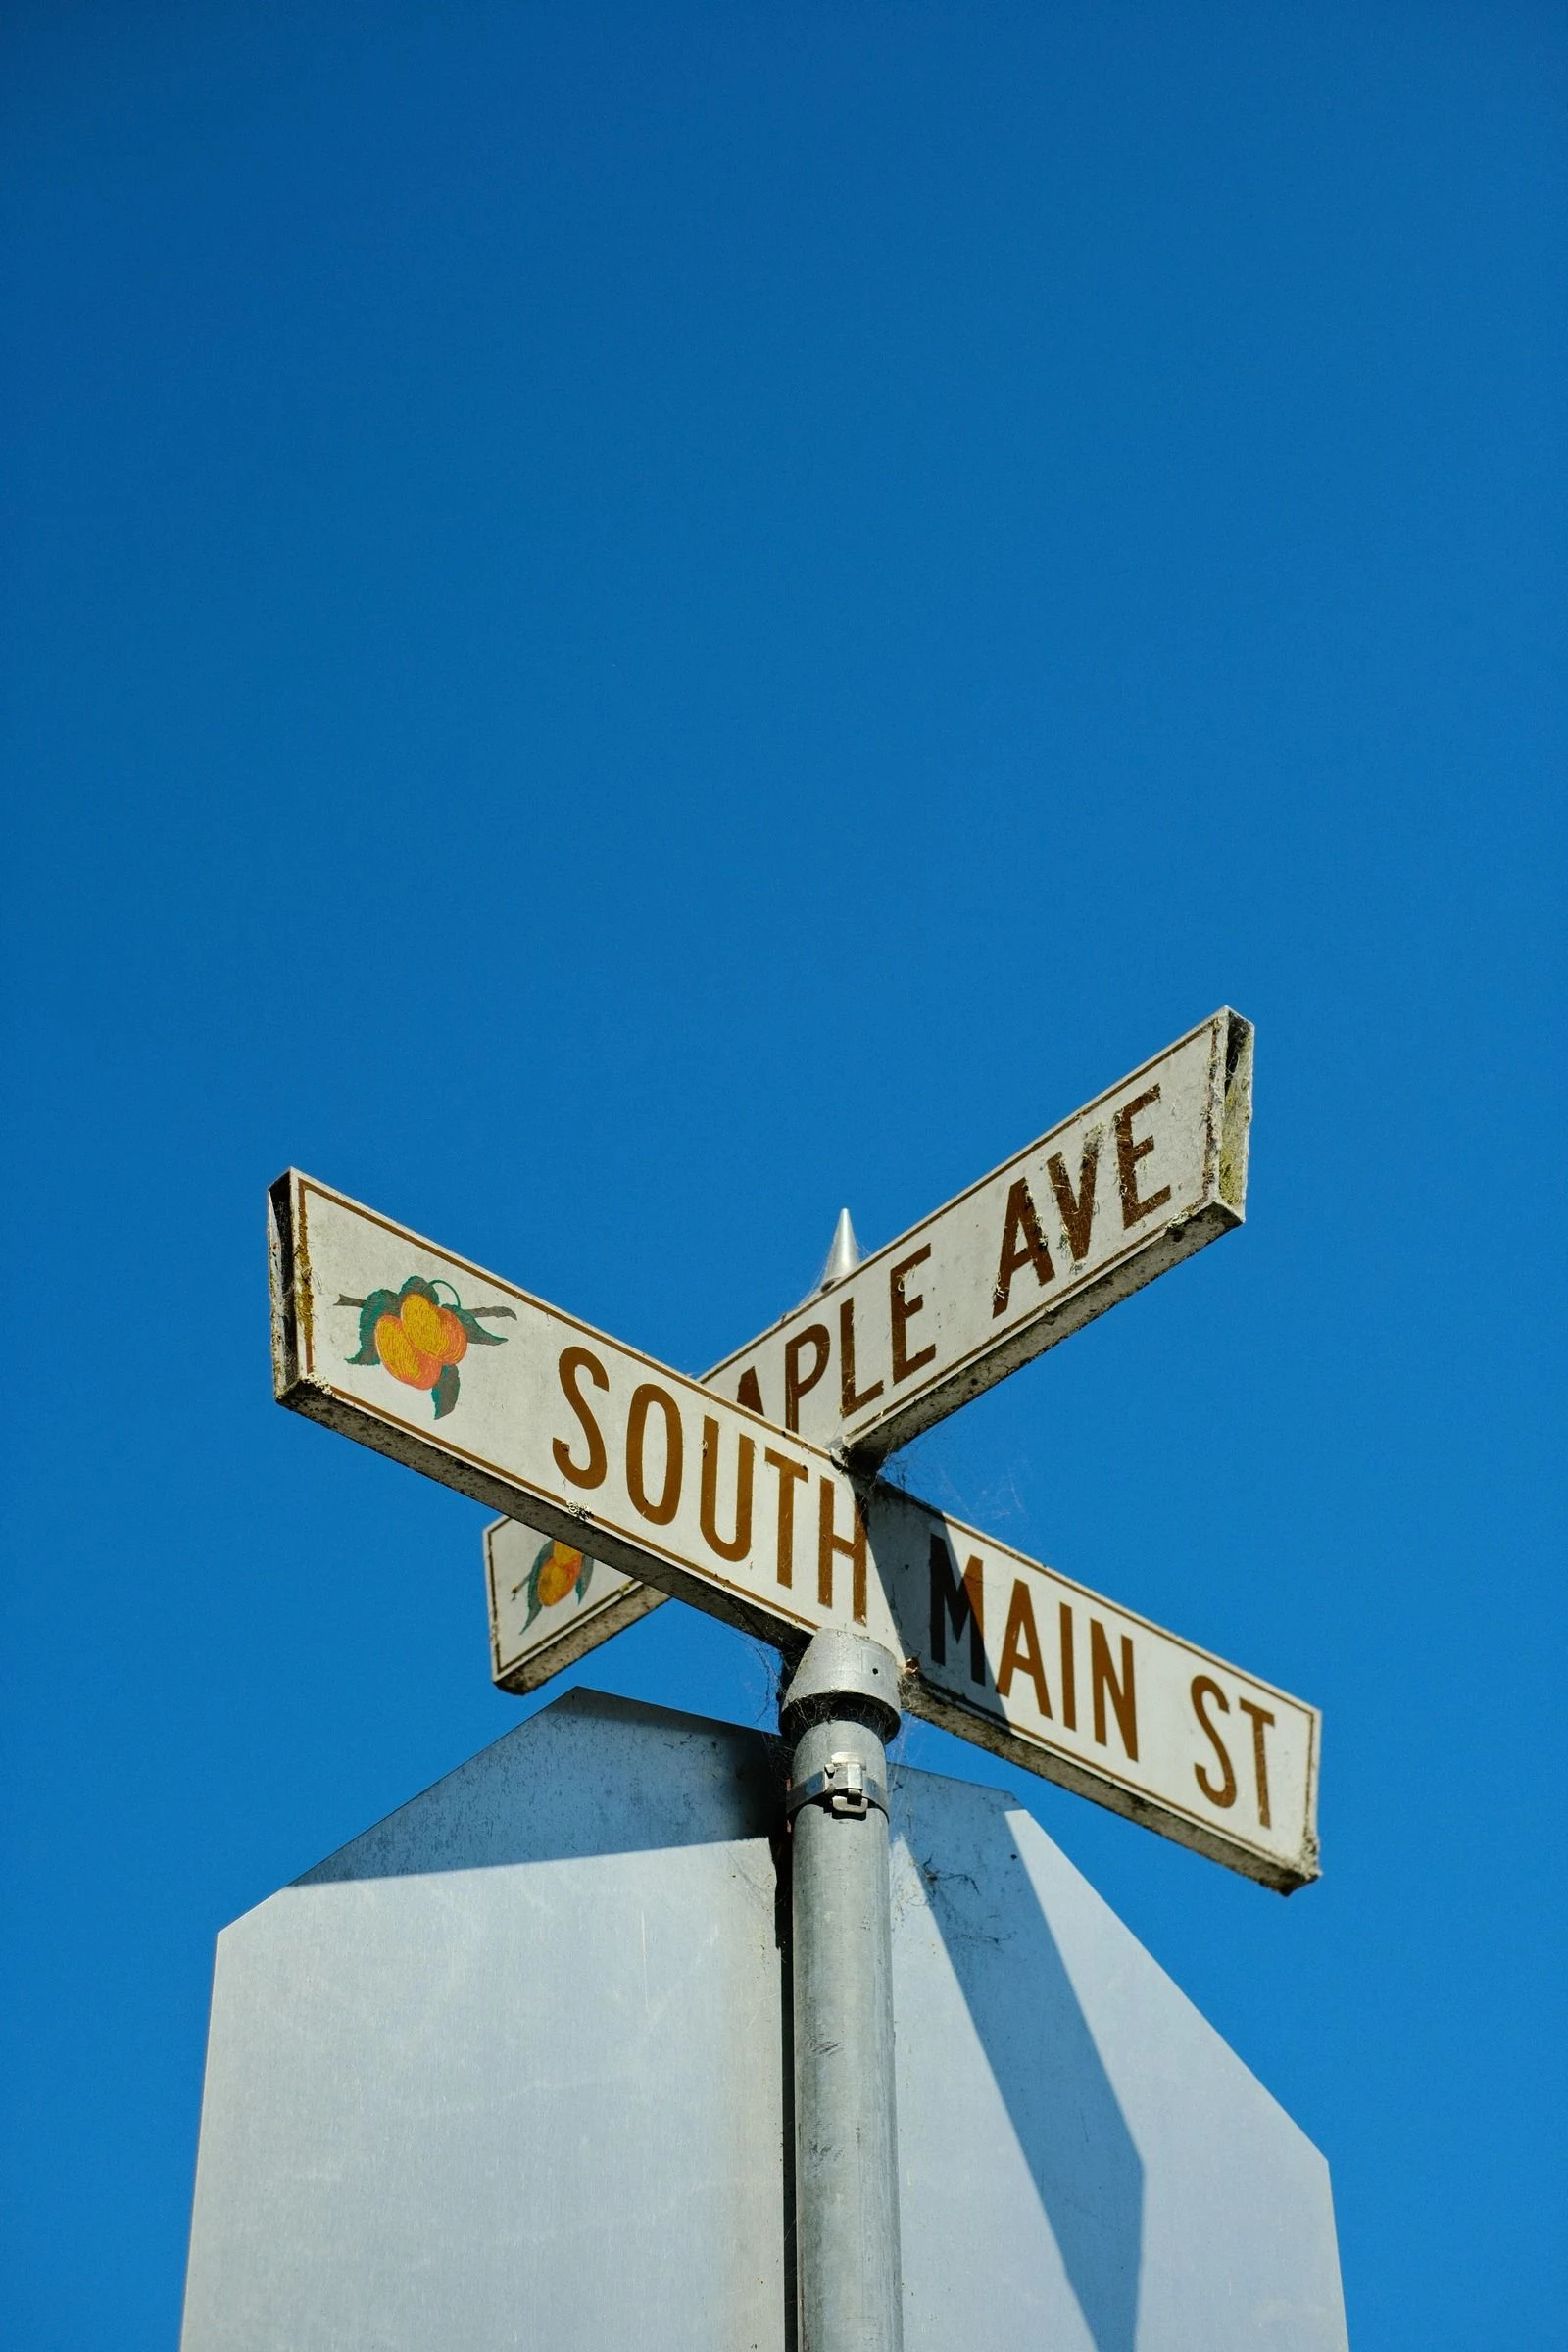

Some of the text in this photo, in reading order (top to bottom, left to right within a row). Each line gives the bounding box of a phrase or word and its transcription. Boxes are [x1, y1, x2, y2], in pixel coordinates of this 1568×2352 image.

[993, 1083, 1172, 1319] AVE
[552, 1346, 1276, 1831] SOUTH MAIN ST
